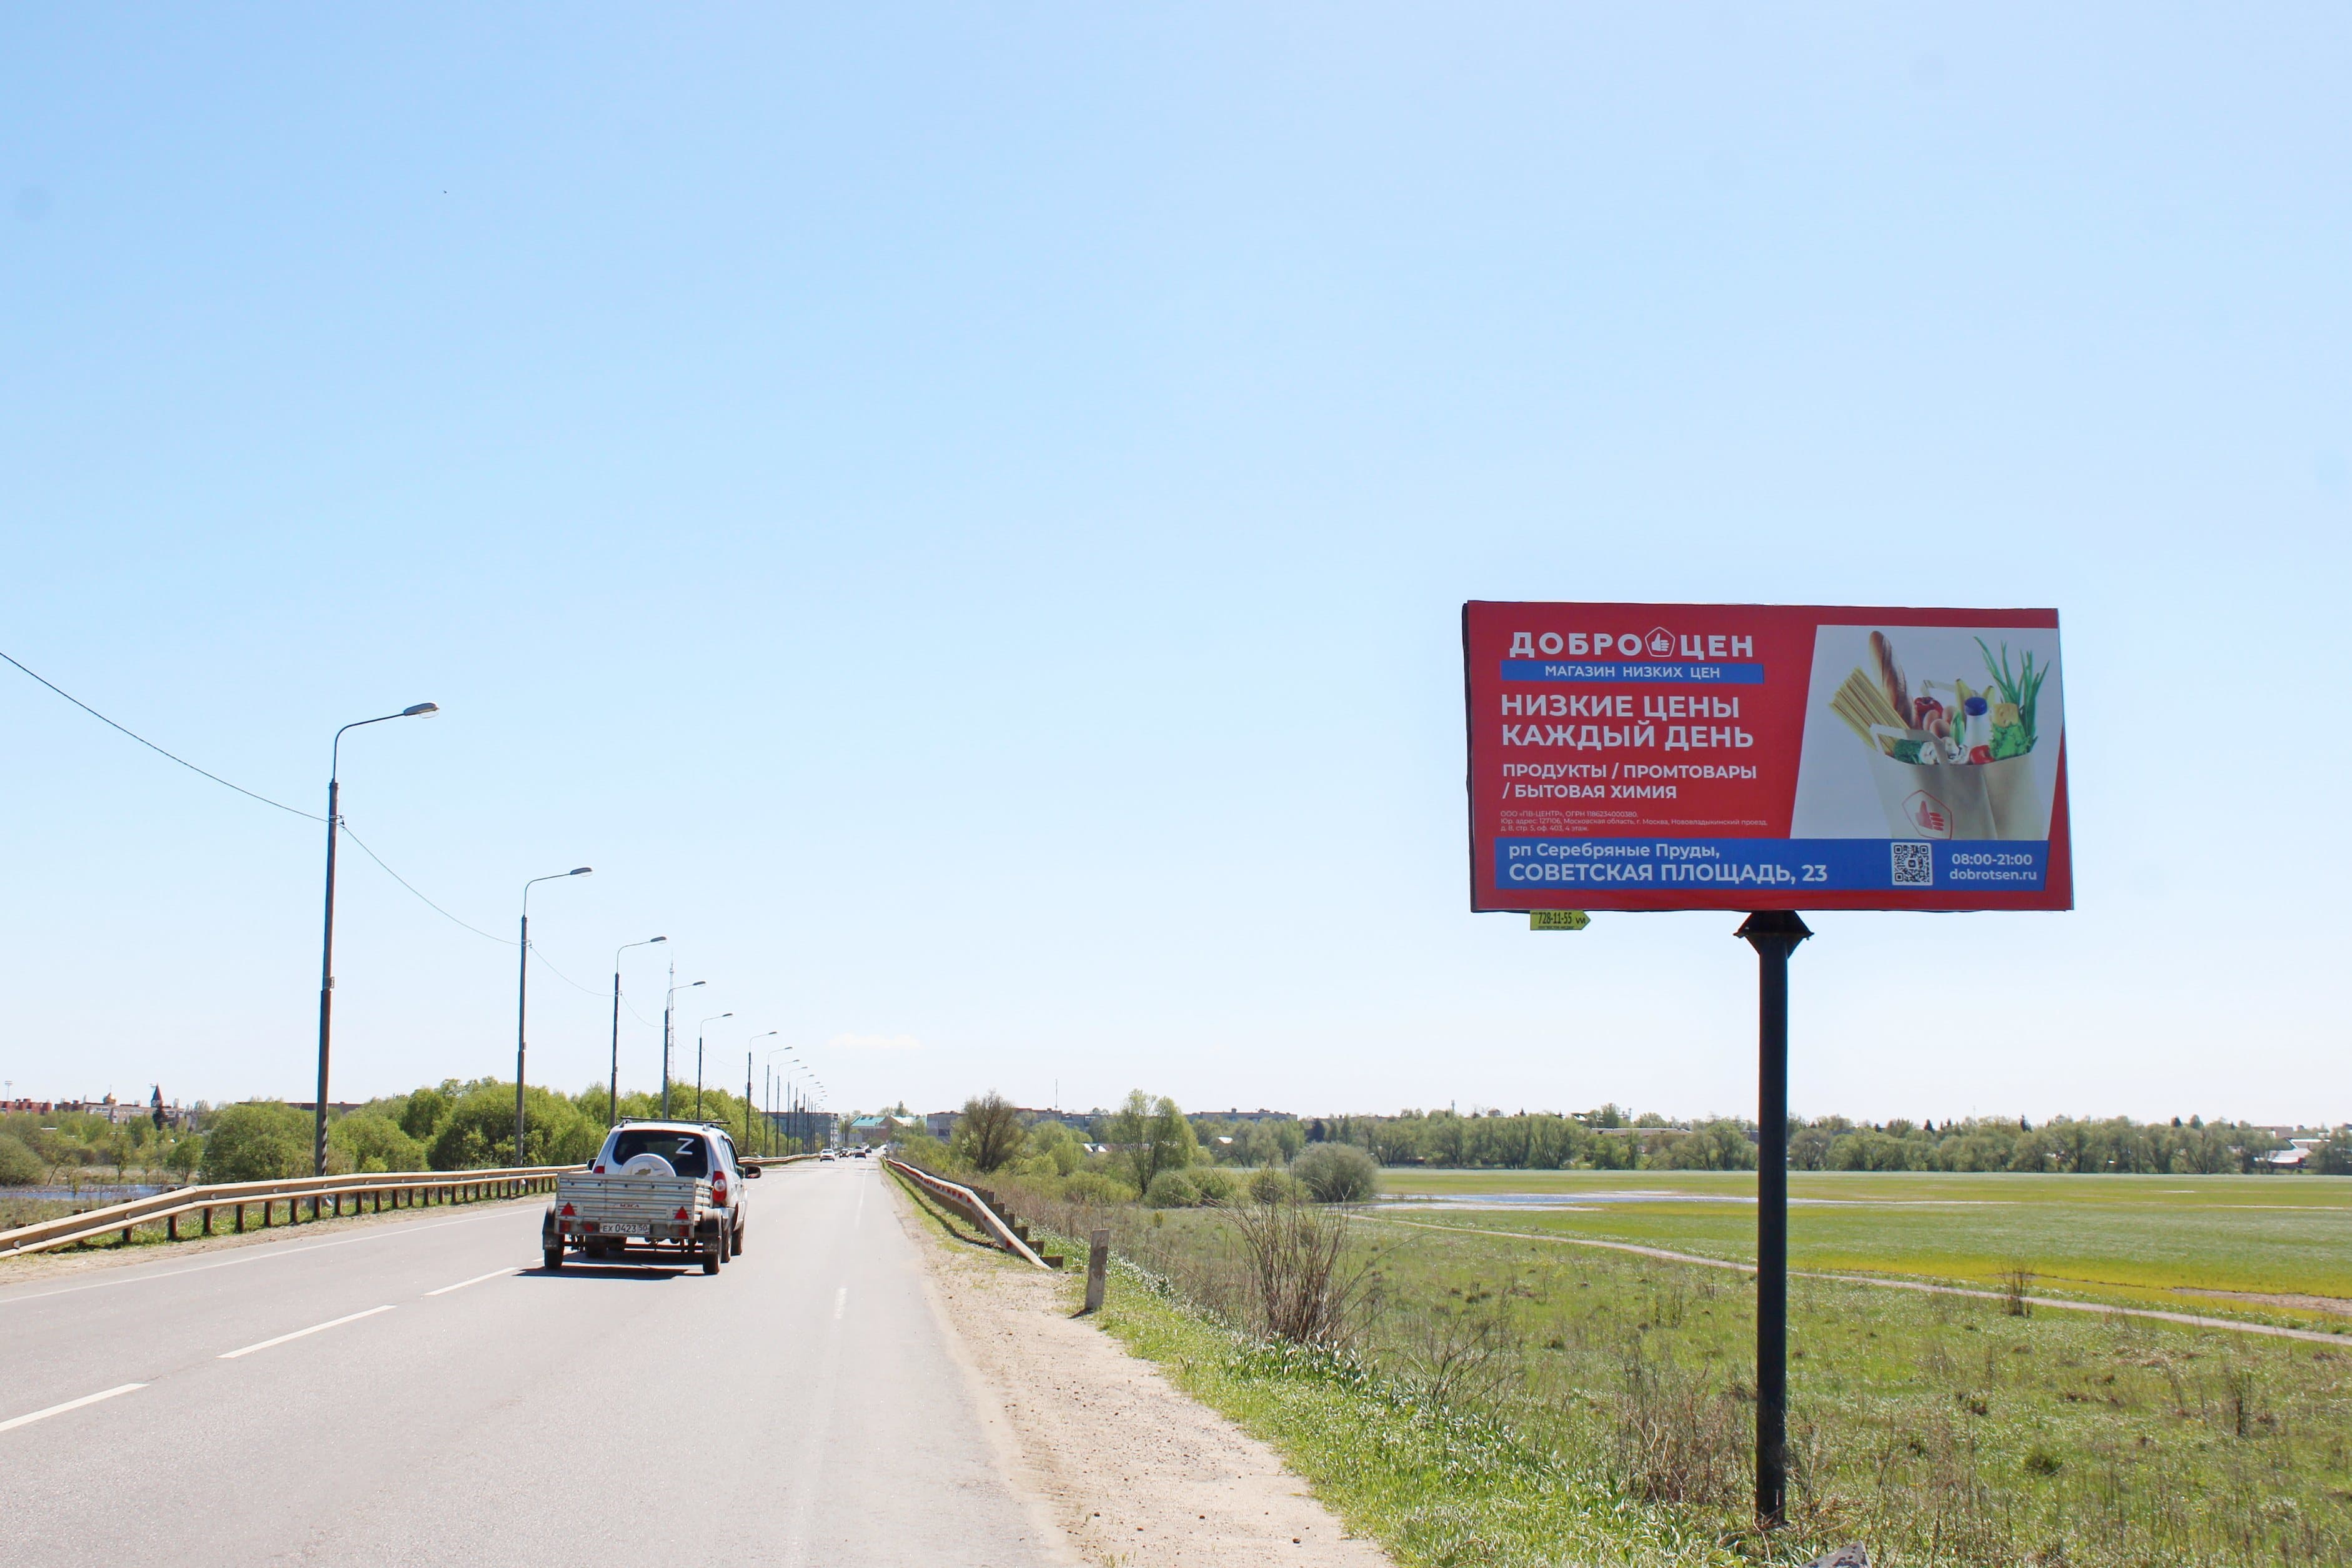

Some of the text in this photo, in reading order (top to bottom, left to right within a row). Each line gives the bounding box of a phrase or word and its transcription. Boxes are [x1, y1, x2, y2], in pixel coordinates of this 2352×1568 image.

[1545, 665, 1720, 679] МАГАЗИН НИЗКИХ ЦЕН
[1501, 694, 1740, 722] НИЗКИЕ ЦЕНЫ
[1502, 720, 1754, 752] КАЖДЫЙ ДЕНЬ
[1503, 763, 1607, 780] ПРОДУКТЫ
[1624, 764, 1757, 779] ПРОМТОВАРЫ
[1515, 784, 1605, 798] БЫТОВАЯ
[1610, 785, 1677, 799] ХИМИЯ
[1509, 842, 1720, 860] рп Серебряные Пруды,
[1952, 853, 2033, 866] 08:00-21:00
[1509, 863, 1828, 885] СОВЕТСКАЯ ПЛОЩАДЬ, 23
[1950, 868, 2038, 880] dobrotsen.ru
[1538, 912, 1572, 924] 728-11-55
[675, 1137, 695, 1155] Z
[615, 1224, 637, 1233] 0423
